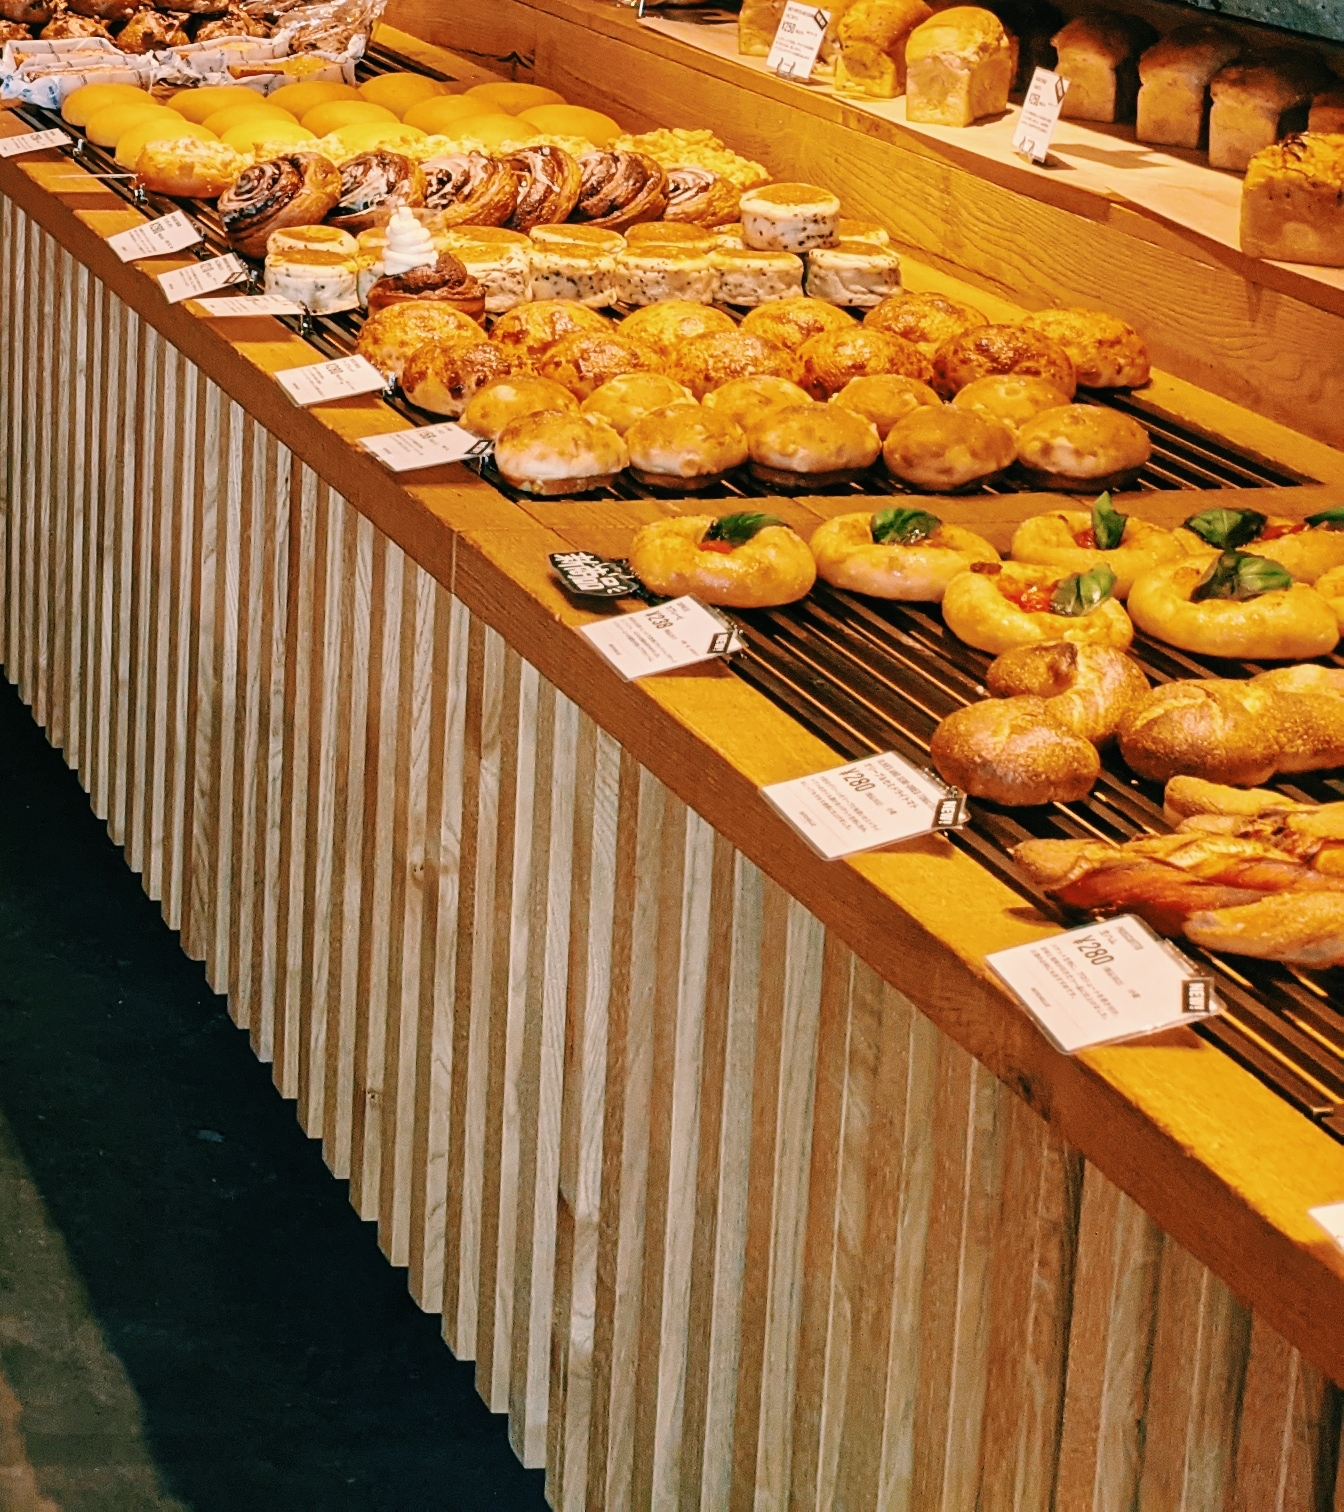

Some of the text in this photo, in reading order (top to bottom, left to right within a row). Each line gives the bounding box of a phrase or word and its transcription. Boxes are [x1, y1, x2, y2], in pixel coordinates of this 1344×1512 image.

[645, 610, 674, 630] ¥238
[836, 766, 877, 793] ¥280
[1069, 934, 1116, 967] ¥280
